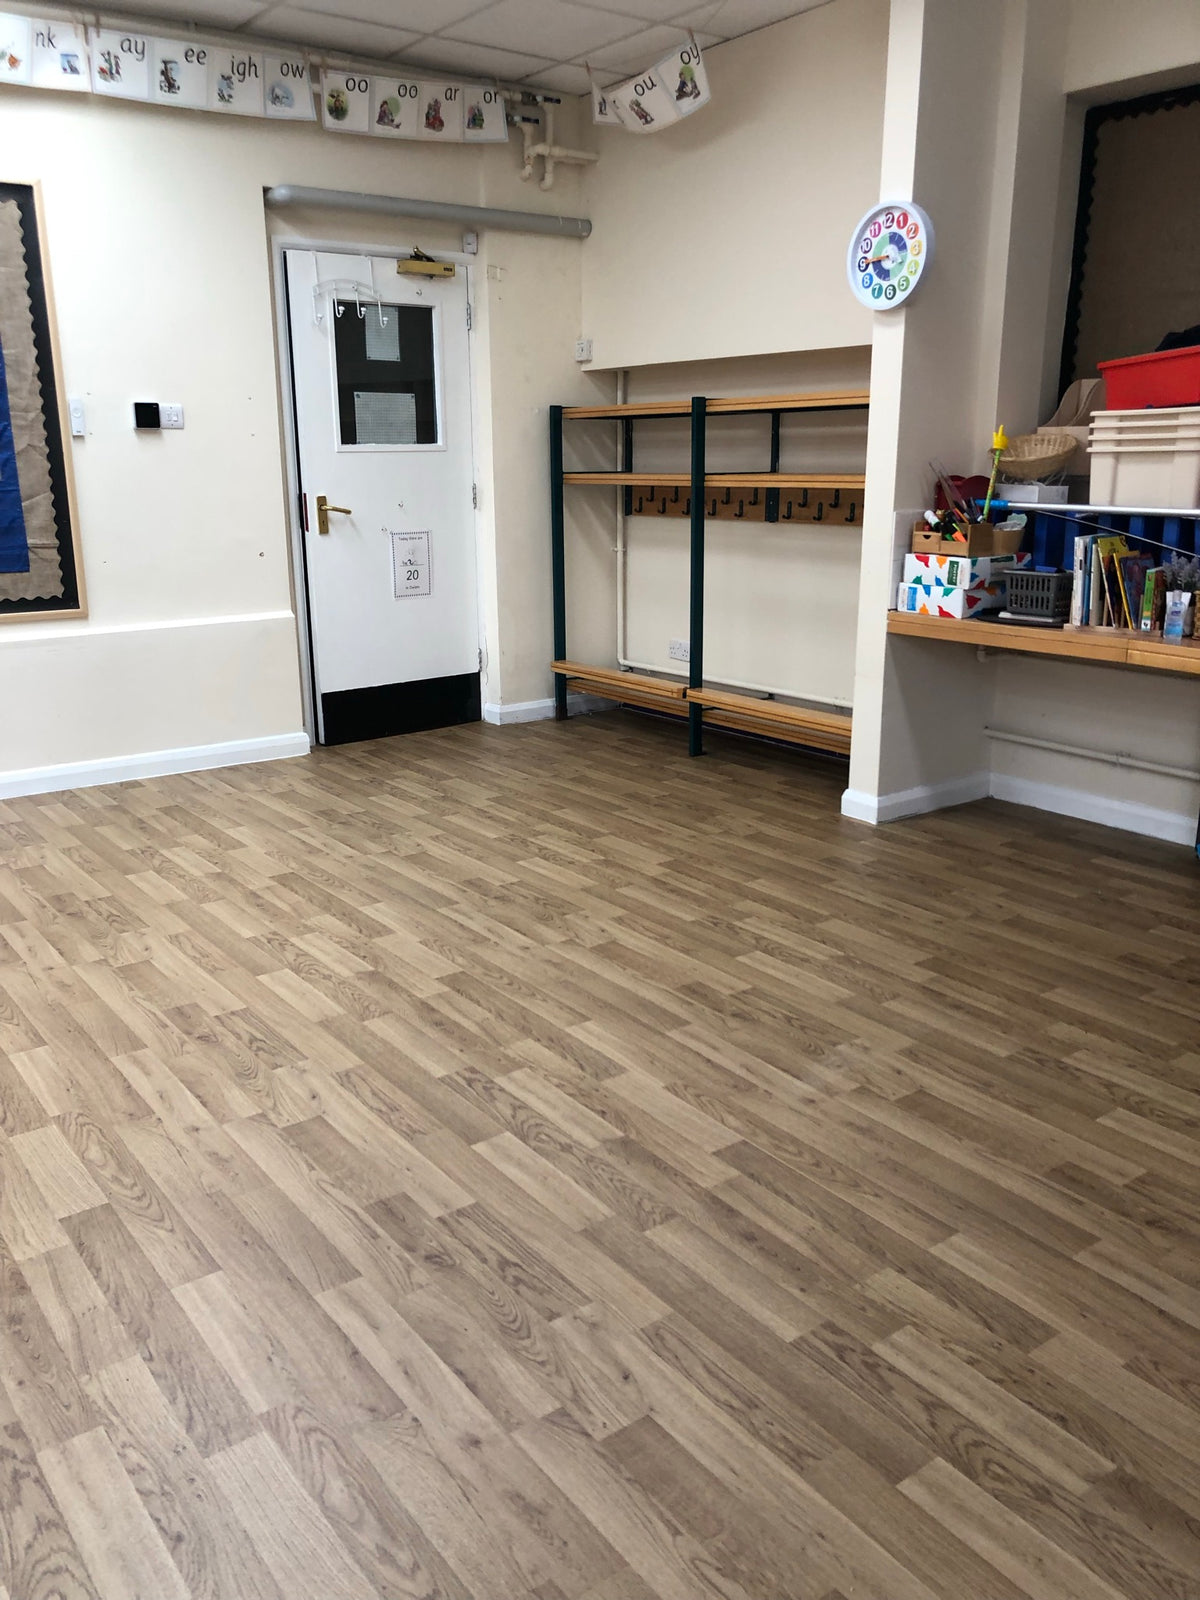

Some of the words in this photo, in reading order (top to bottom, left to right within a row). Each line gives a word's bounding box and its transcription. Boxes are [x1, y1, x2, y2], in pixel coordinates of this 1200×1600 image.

[35, 26, 57, 49] nk
[120, 36, 146, 62] ay
[184, 47, 207, 65] ee
[680, 43, 701, 66] oy
[230, 56, 259, 83] igh
[280, 61, 305, 79] ow
[345, 77, 369, 93] oo
[397, 84, 418, 99] oo
[634, 75, 657, 97] ou
[444, 87, 460, 102] ar
[483, 90, 499, 104] or
[882, 213, 894, 229] 12
[870, 223, 880, 238] 11
[861, 239, 871, 254] 10
[406, 569, 419, 581] 20
